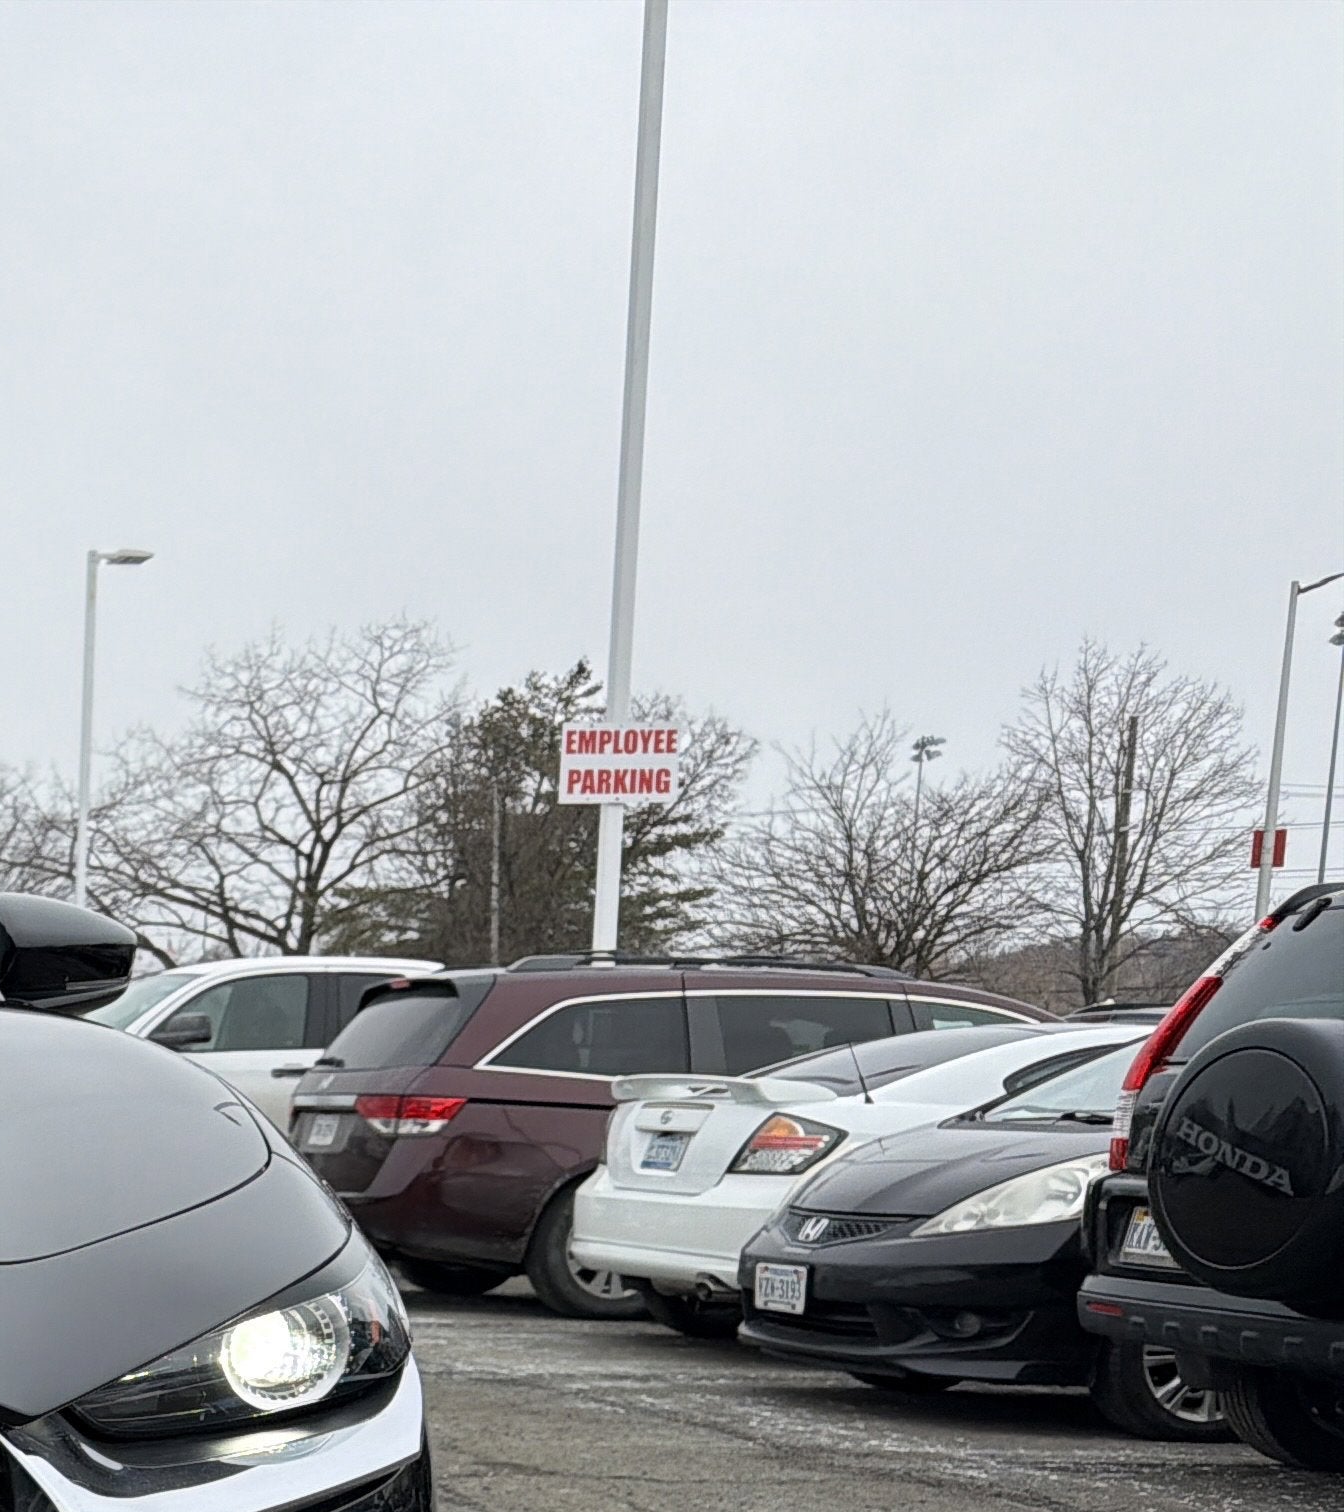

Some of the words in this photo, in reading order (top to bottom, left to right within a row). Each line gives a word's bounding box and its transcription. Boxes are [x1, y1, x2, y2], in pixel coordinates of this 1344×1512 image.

[565, 728, 679, 755] EMPLOYEE
[566, 768, 672, 795] PARKING
[1176, 1116, 1295, 1197] HONDA
